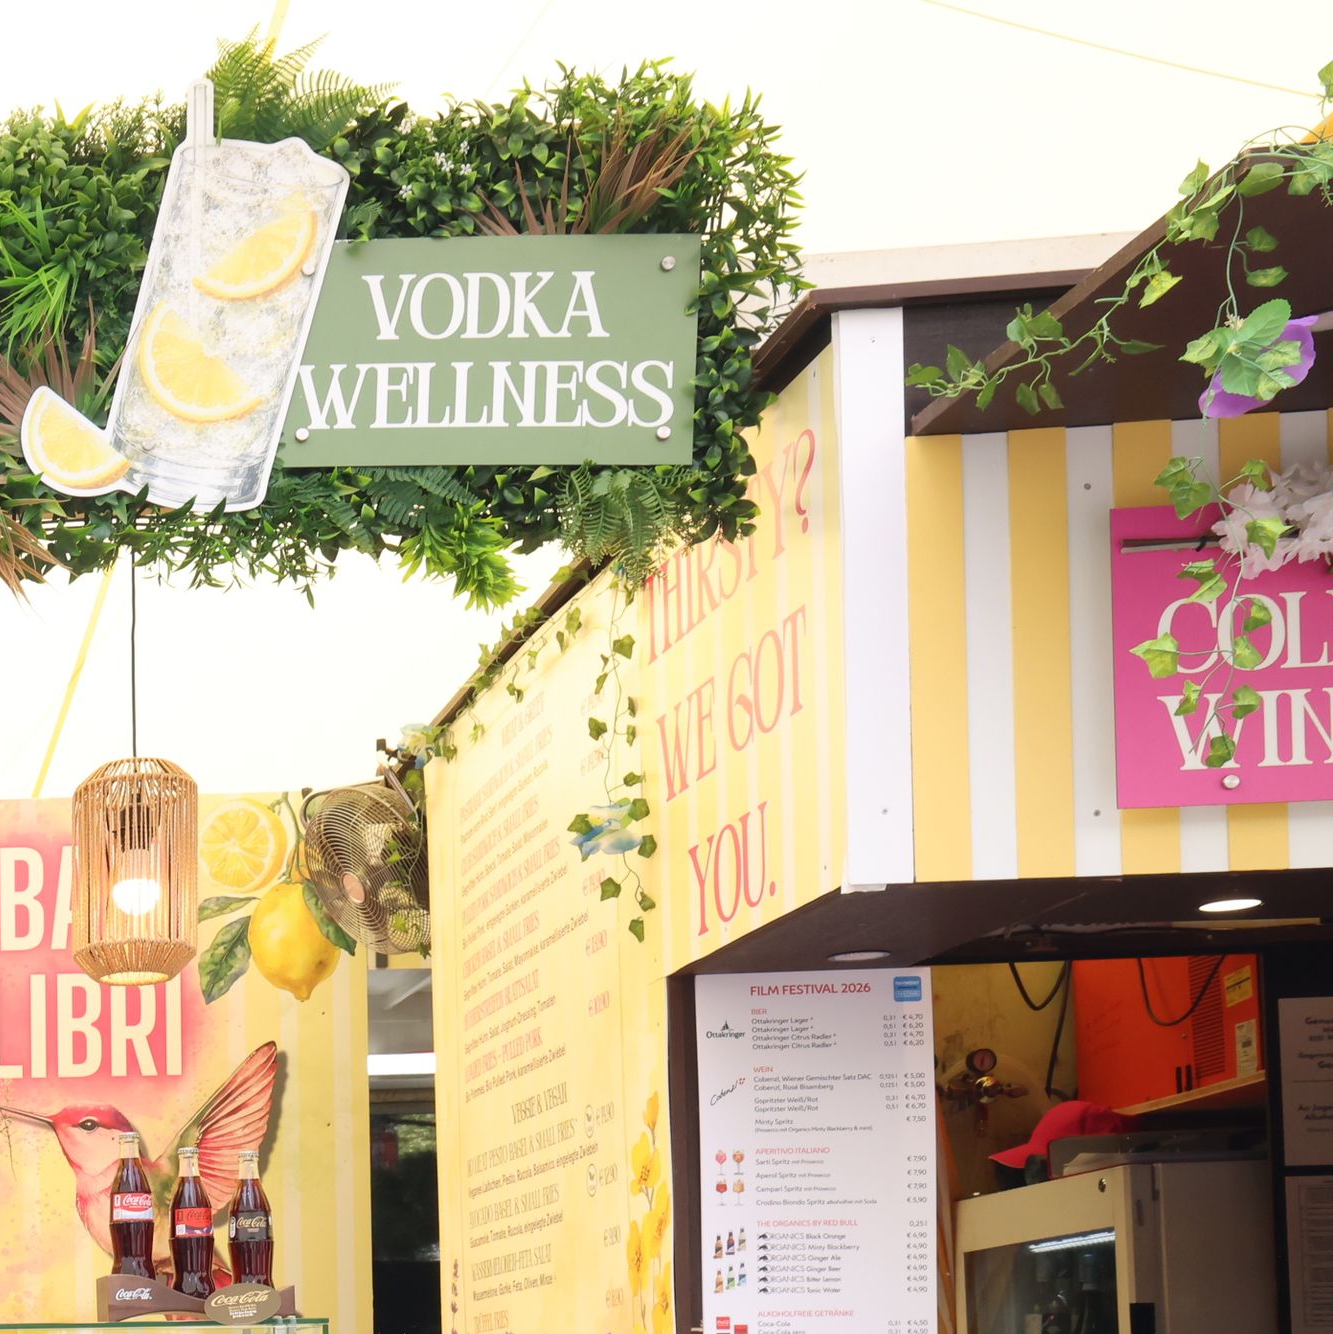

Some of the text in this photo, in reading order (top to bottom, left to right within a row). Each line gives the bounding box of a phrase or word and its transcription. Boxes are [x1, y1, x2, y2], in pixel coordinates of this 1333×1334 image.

[362, 270, 609, 341] VODKA
[299, 360, 675, 430] WELLNESS
[1157, 589, 1333, 674] COL
[656, 677, 717, 801] WE
[727, 605, 807, 752] GOT
[688, 801, 775, 936] YOU.
[750, 982, 871, 996] FILM FESTIVAL 2026
